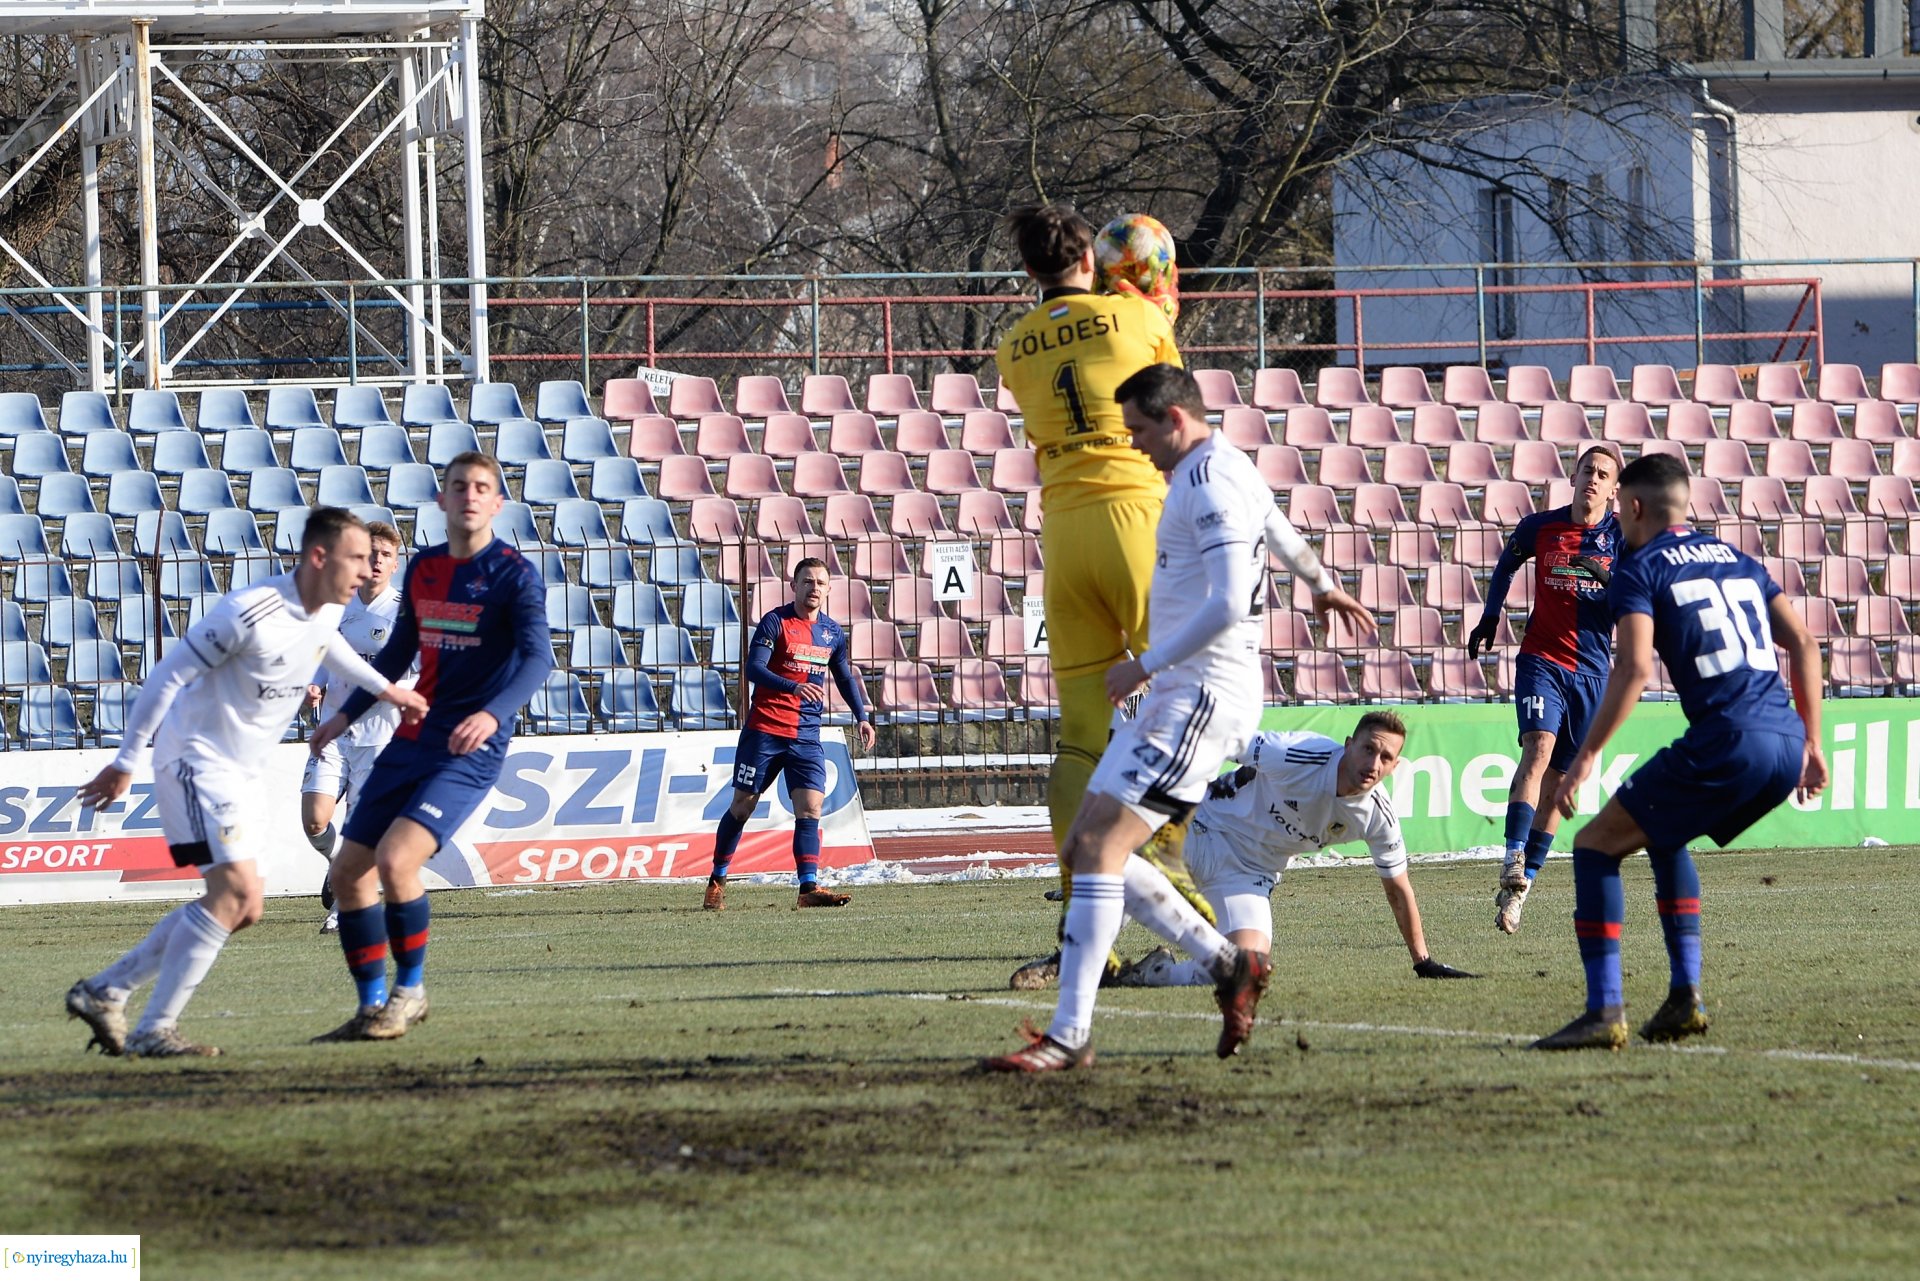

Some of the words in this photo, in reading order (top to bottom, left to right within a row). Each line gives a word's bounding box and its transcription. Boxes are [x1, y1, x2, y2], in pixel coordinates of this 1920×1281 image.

[1052, 360, 1099, 436] 1
[936, 546, 954, 554] KELETI
[1662, 544, 1738, 566] HAMED
[942, 566, 965, 594] A
[1670, 578, 1778, 679] 30
[1523, 695, 1544, 719] 14
[737, 763, 757, 786] 22
[0, 783, 163, 835] SZI-Z
[1, 844, 112, 869] SPORT
[513, 842, 689, 883] SPORT
